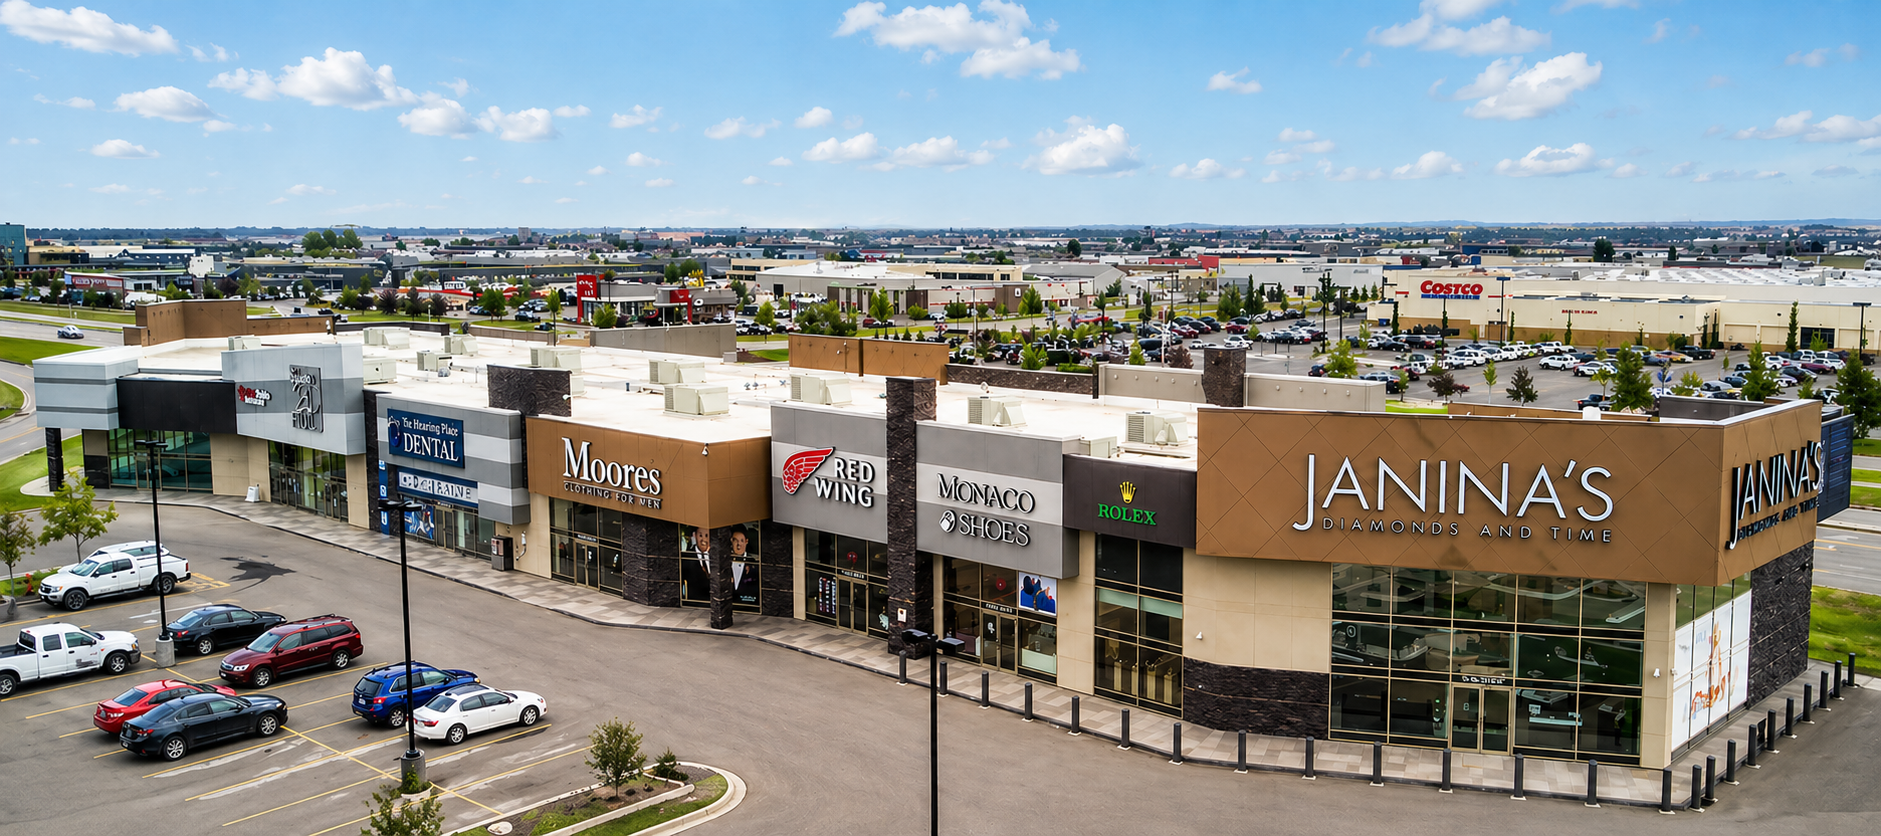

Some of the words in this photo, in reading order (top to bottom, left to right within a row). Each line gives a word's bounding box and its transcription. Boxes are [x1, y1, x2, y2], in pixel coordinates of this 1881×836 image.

[1420, 280, 1484, 296] COSTCO
[413, 418, 440, 435] Hearing
[441, 423, 458, 437] Place
[403, 432, 459, 462] DENTAL
[561, 436, 661, 496] Moores
[834, 456, 875, 484] RED
[564, 482, 610, 499] CLOTHING
[615, 493, 634, 505] FOR
[639, 498, 661, 510] MEN
[814, 476, 875, 509] WING
[937, 472, 1036, 514] MONACO
[1292, 453, 1614, 531] JANINA'S
[1726, 440, 1823, 550] JANINA'S
[1097, 503, 1157, 526] ROLEX
[958, 513, 1032, 547] SHOES
[1322, 517, 1459, 537] DIAMONDS
[1479, 524, 1532, 540] AND
[1550, 526, 1612, 543] TIME
